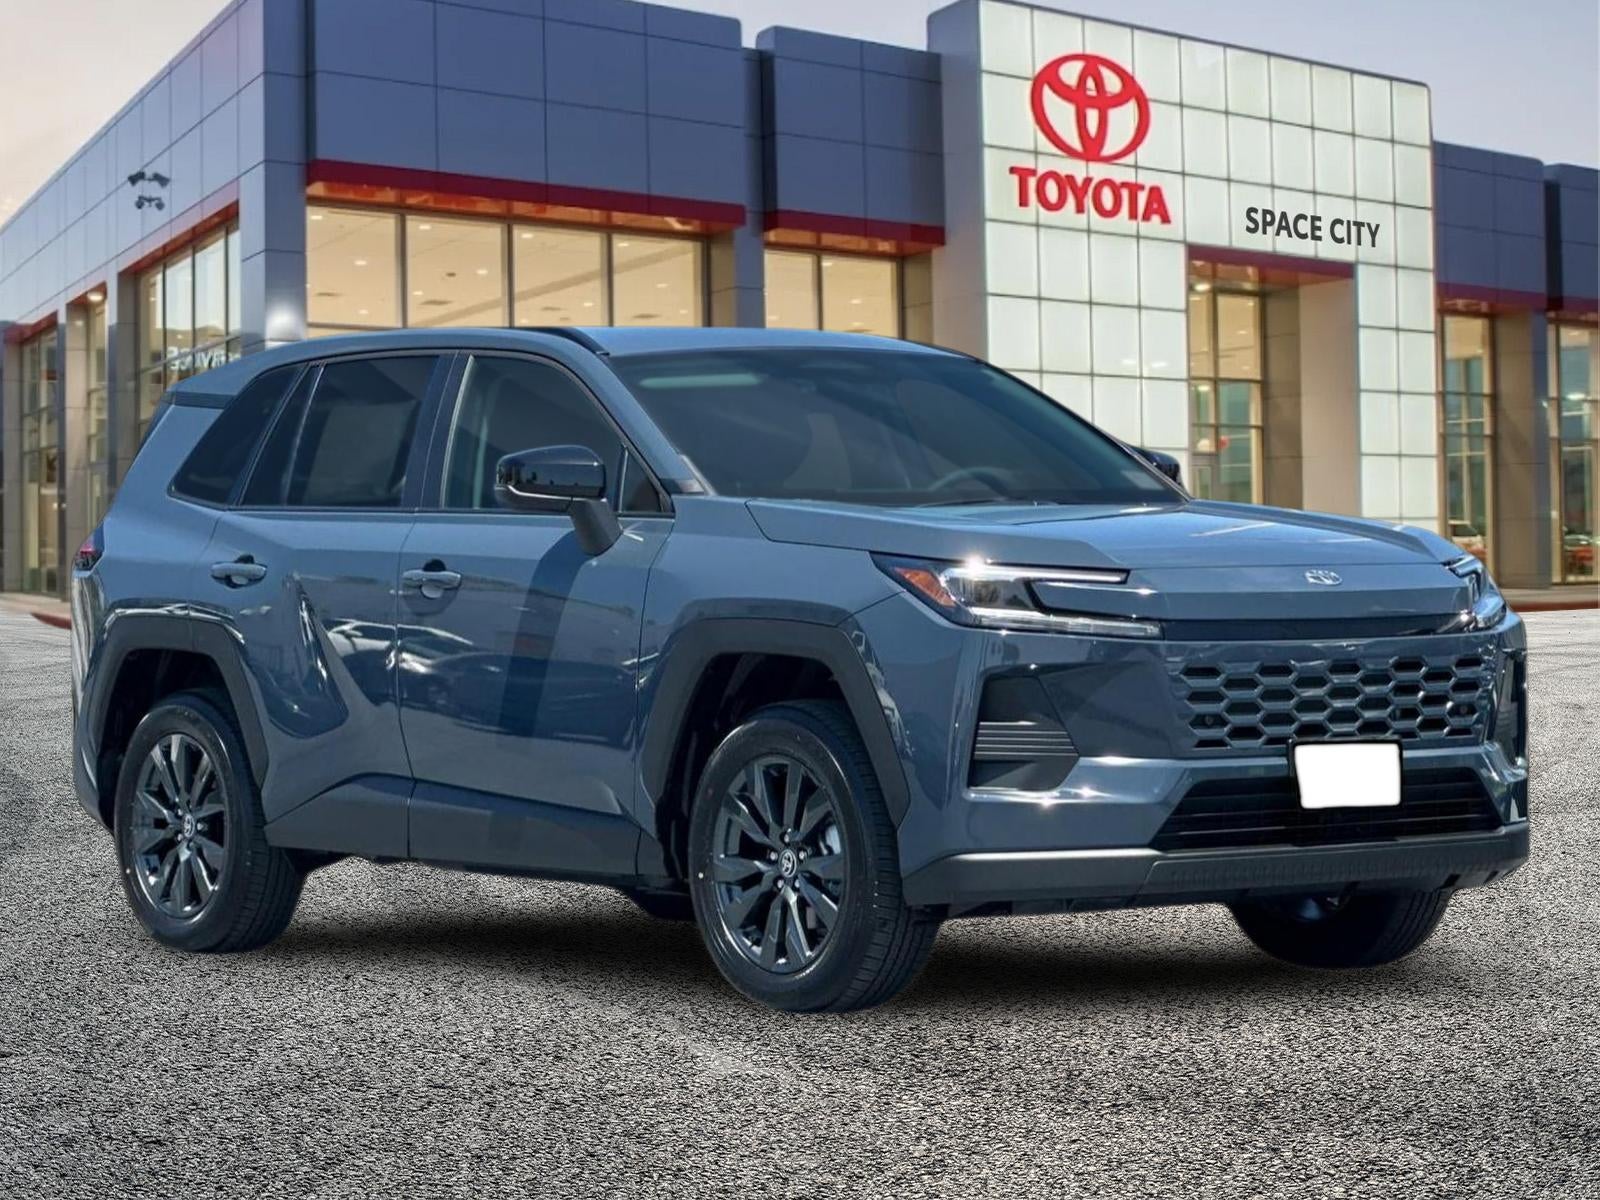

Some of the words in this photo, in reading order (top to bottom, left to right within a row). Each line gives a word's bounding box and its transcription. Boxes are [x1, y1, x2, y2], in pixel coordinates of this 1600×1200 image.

[1009, 166, 1171, 224] TOYOTA
[1245, 206, 1323, 241] SPACE
[1329, 218, 1380, 248] CITY
